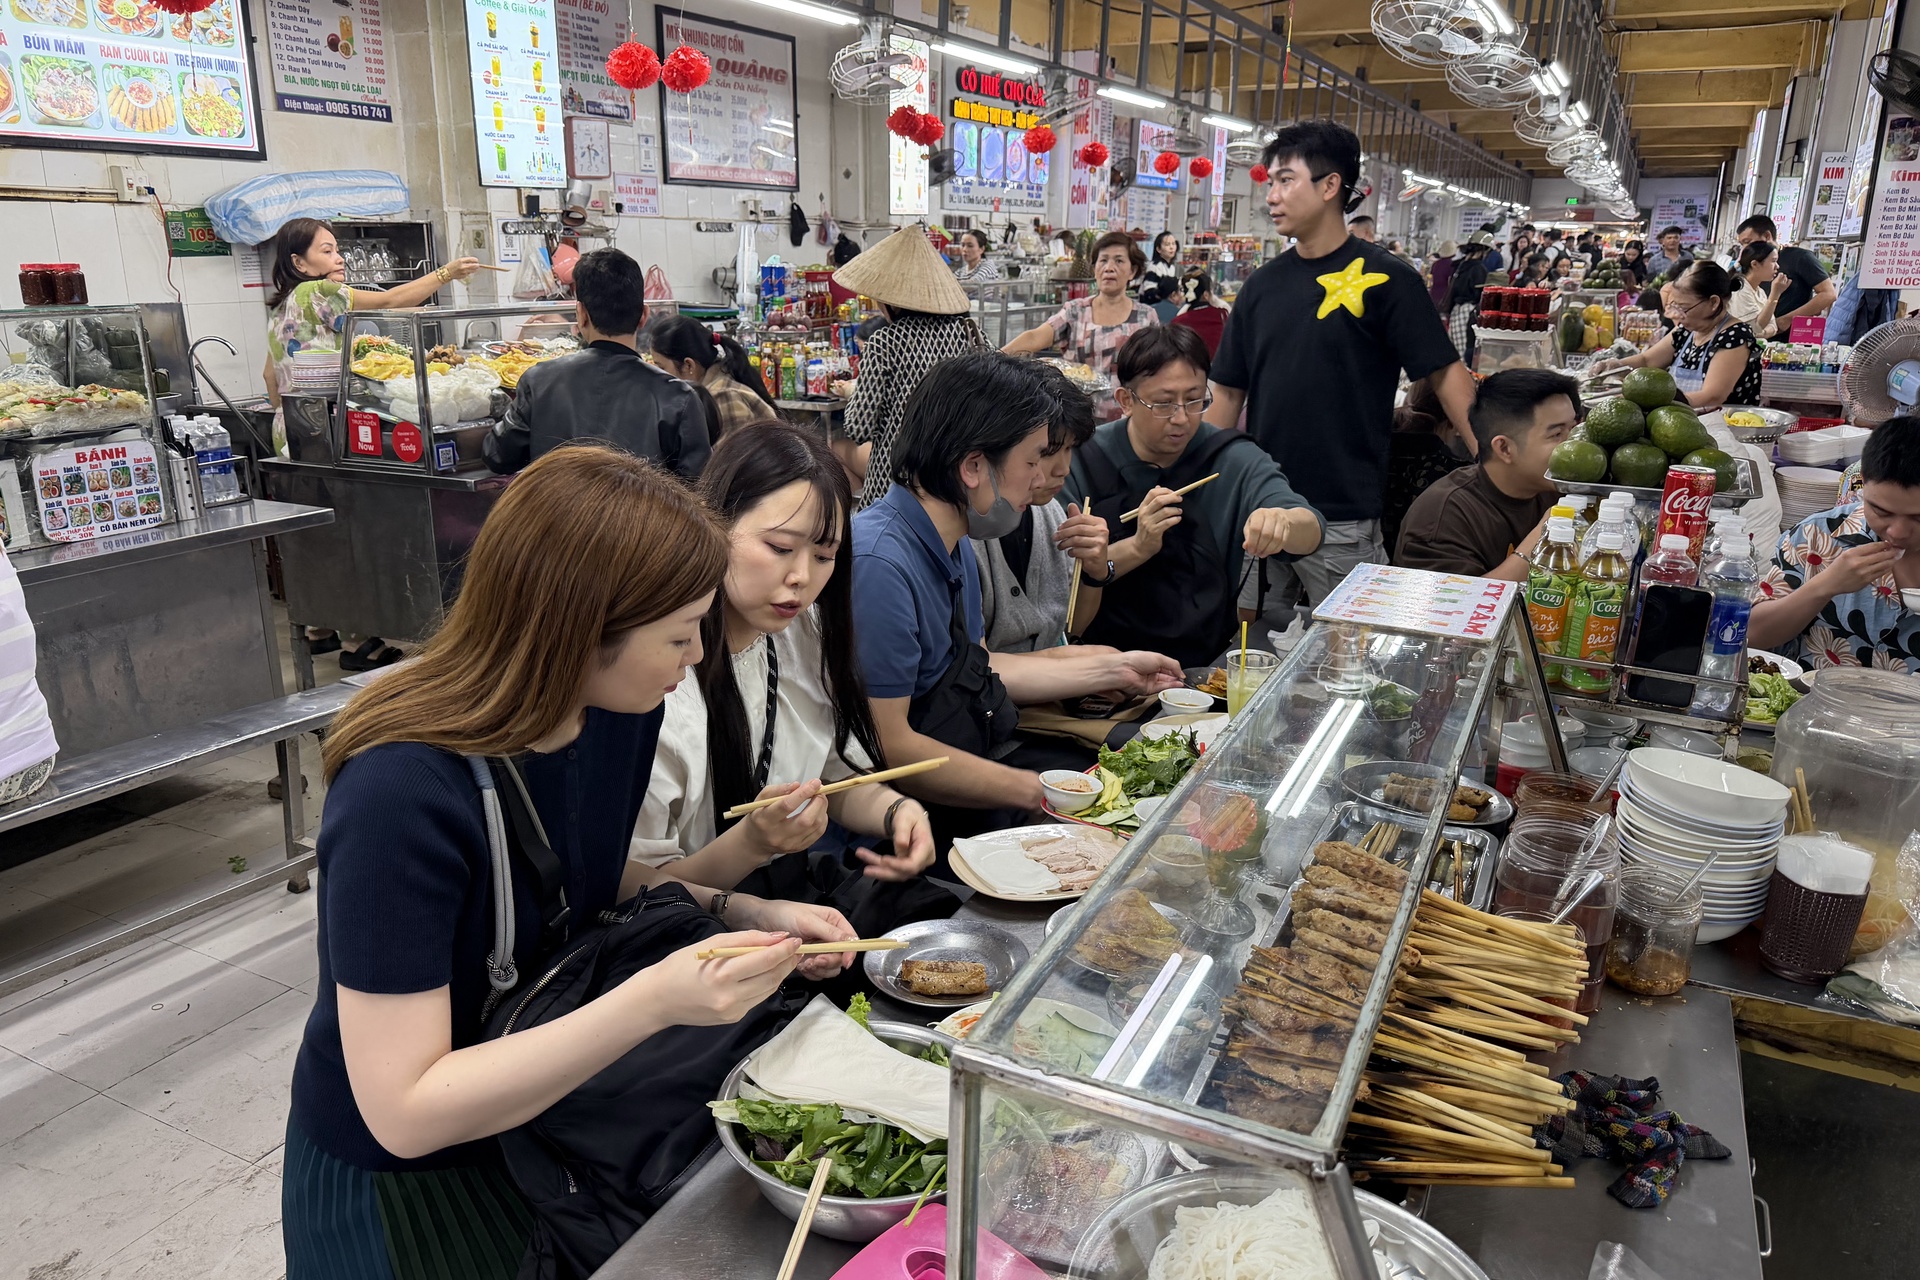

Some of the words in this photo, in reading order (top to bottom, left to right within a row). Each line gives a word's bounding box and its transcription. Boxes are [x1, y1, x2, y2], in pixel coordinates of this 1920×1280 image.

[360, 7, 380, 17] 15.000
[278, 12, 298, 22] Chanh
[362, 27, 382, 36] 15.000
[361, 17, 381, 27] 15.000
[23, 33, 50, 51] BÚN
[99, 44, 122, 60] RAM
[363, 37, 383, 46] 15.000
[364, 47, 383, 56] 15.000
[365, 66, 385, 75] 20.000
[716, 58, 788, 85] QUẢNG
[284, 74, 299, 85] BIA,
[321, 80, 339, 91] NGỌT
[352, 83, 366, 93] CÁC
[366, 76, 386, 85] 15.000
[961, 66, 978, 92] CÔ
[981, 72, 1002, 98] HUẾ
[1004, 80, 1024, 105] CHỢ
[284, 98, 302, 110] Điện
[326, 101, 350, 114] 0905
[351, 104, 369, 117] 516
[370, 106, 387, 119] 741
[1823, 167, 1845, 179] KIM
[1890, 170, 1920, 181] Kim
[1901, 187, 1910, 195] Bơ
[1885, 196, 1899, 204] Kem
[1899, 196, 1908, 204] Bơ
[1898, 205, 1907, 213] Bơ
[188, 227, 222, 242] 105
[1885, 276, 1920, 286] NƯỚC
[358, 442, 375, 452] Now
[75, 447, 127, 464] BÁNH
[100, 524, 111, 533] CÓ
[112, 521, 128, 531] BÁN
[130, 518, 147, 528] NEM
[1534, 590, 1563, 605] Cozy
[1596, 602, 1621, 615] Cozy
[1463, 603, 1497, 635] TÂM
[1532, 620, 1546, 631] ào
[1586, 633, 1609, 645] Đào
